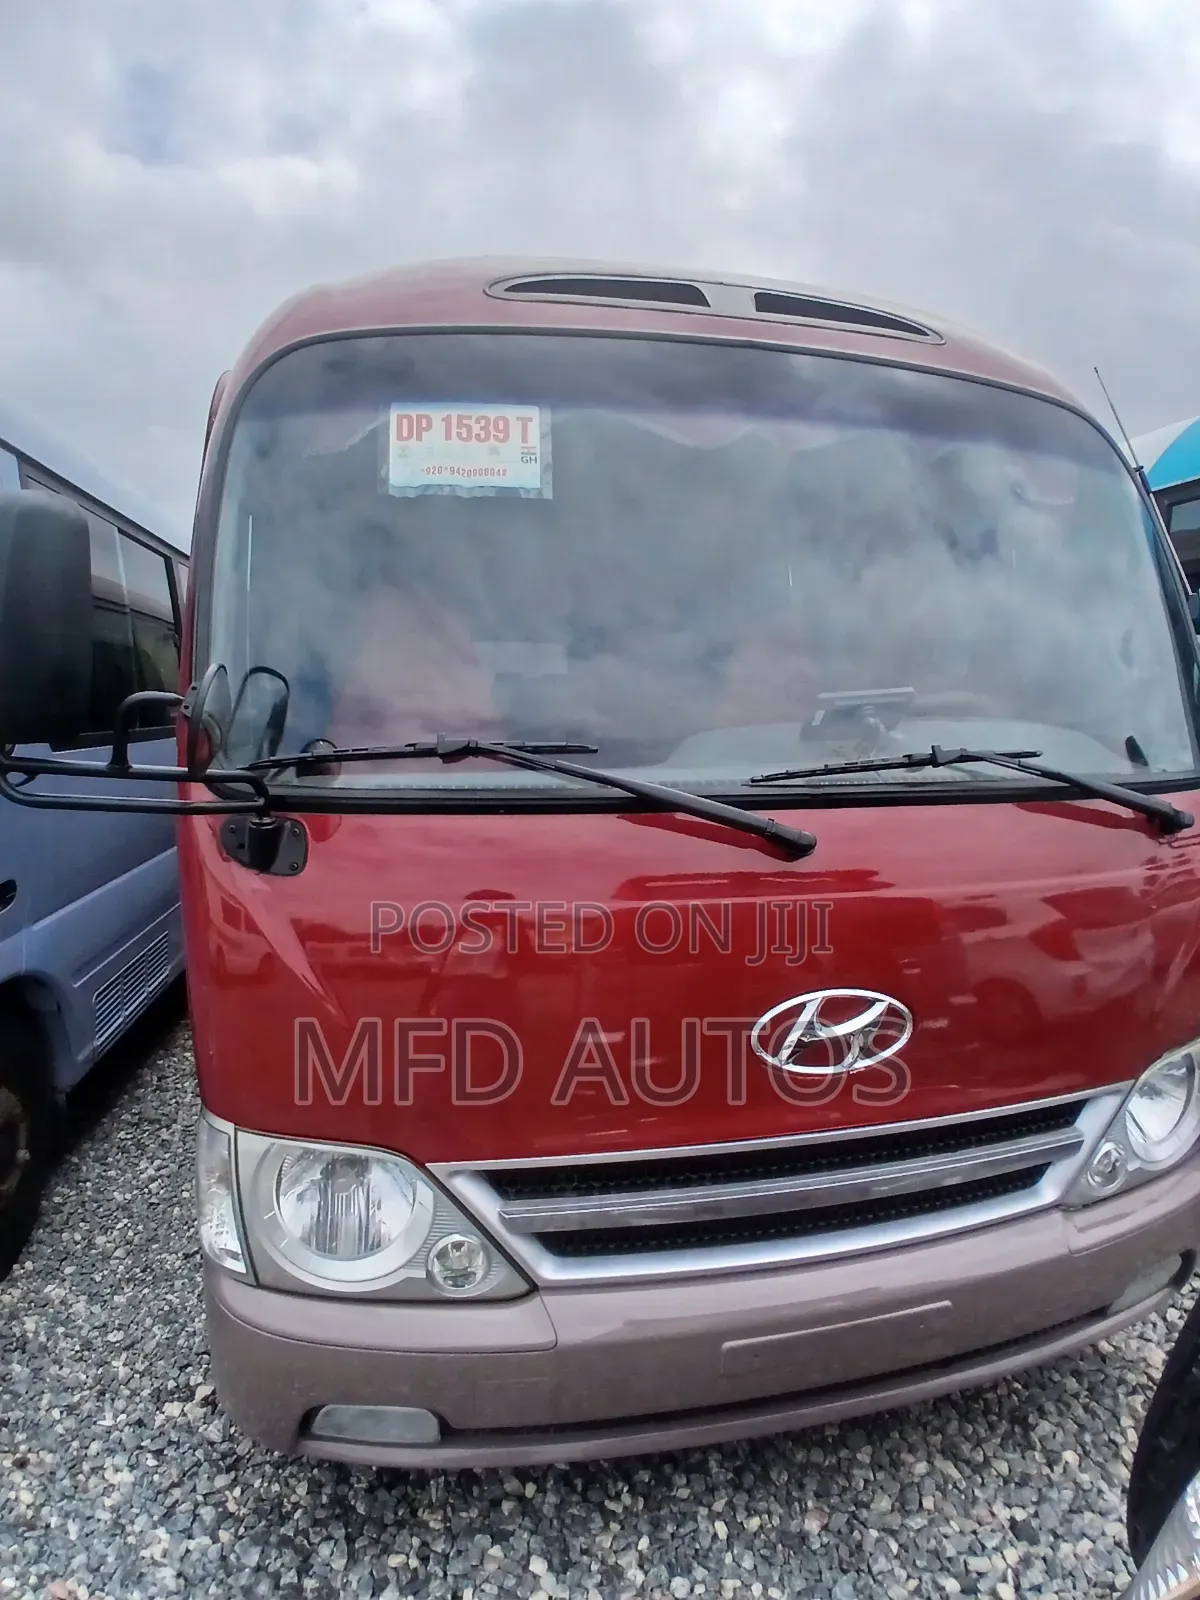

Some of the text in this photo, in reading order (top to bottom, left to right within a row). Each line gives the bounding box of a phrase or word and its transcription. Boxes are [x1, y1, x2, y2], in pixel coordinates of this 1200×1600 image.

[396, 413, 533, 444] DP 1539 T
[520, 456, 538, 464] GH
